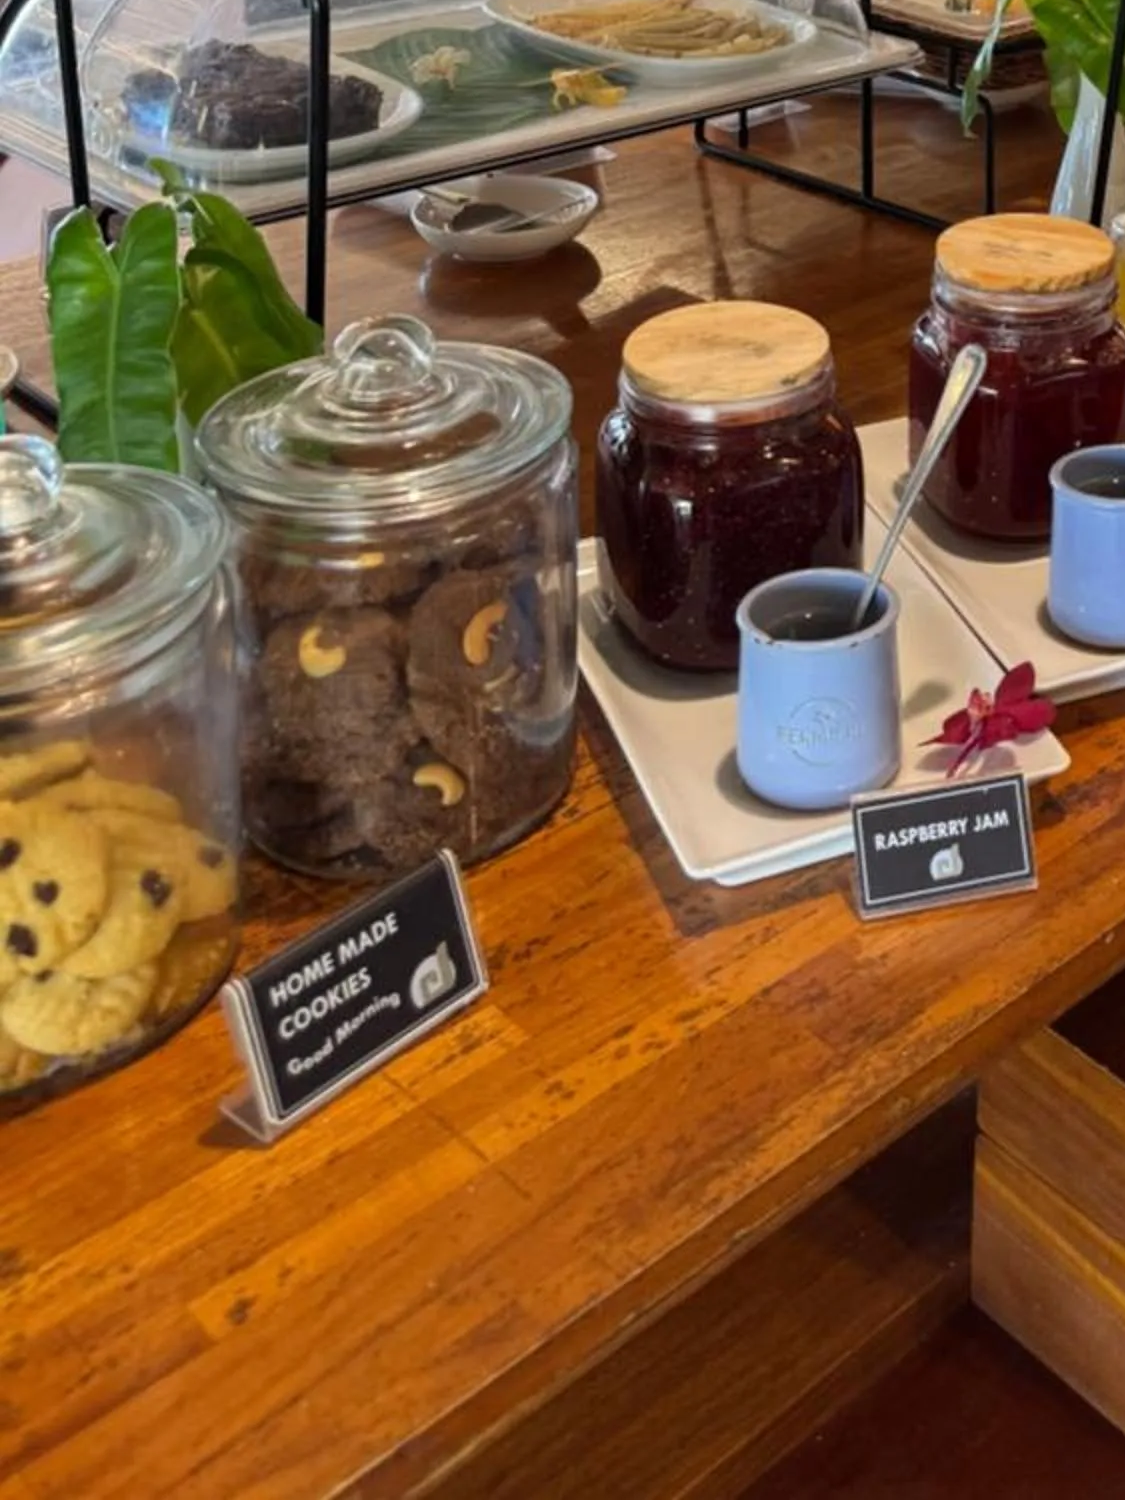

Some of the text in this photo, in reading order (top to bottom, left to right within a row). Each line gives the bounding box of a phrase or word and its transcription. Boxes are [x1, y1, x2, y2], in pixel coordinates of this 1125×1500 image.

[874, 809, 1010, 852] RASPBERRY JAM
[268, 911, 399, 1007] HOME MADE
[278, 967, 372, 1040] COOKIES
[287, 990, 401, 1076] Good Morning
